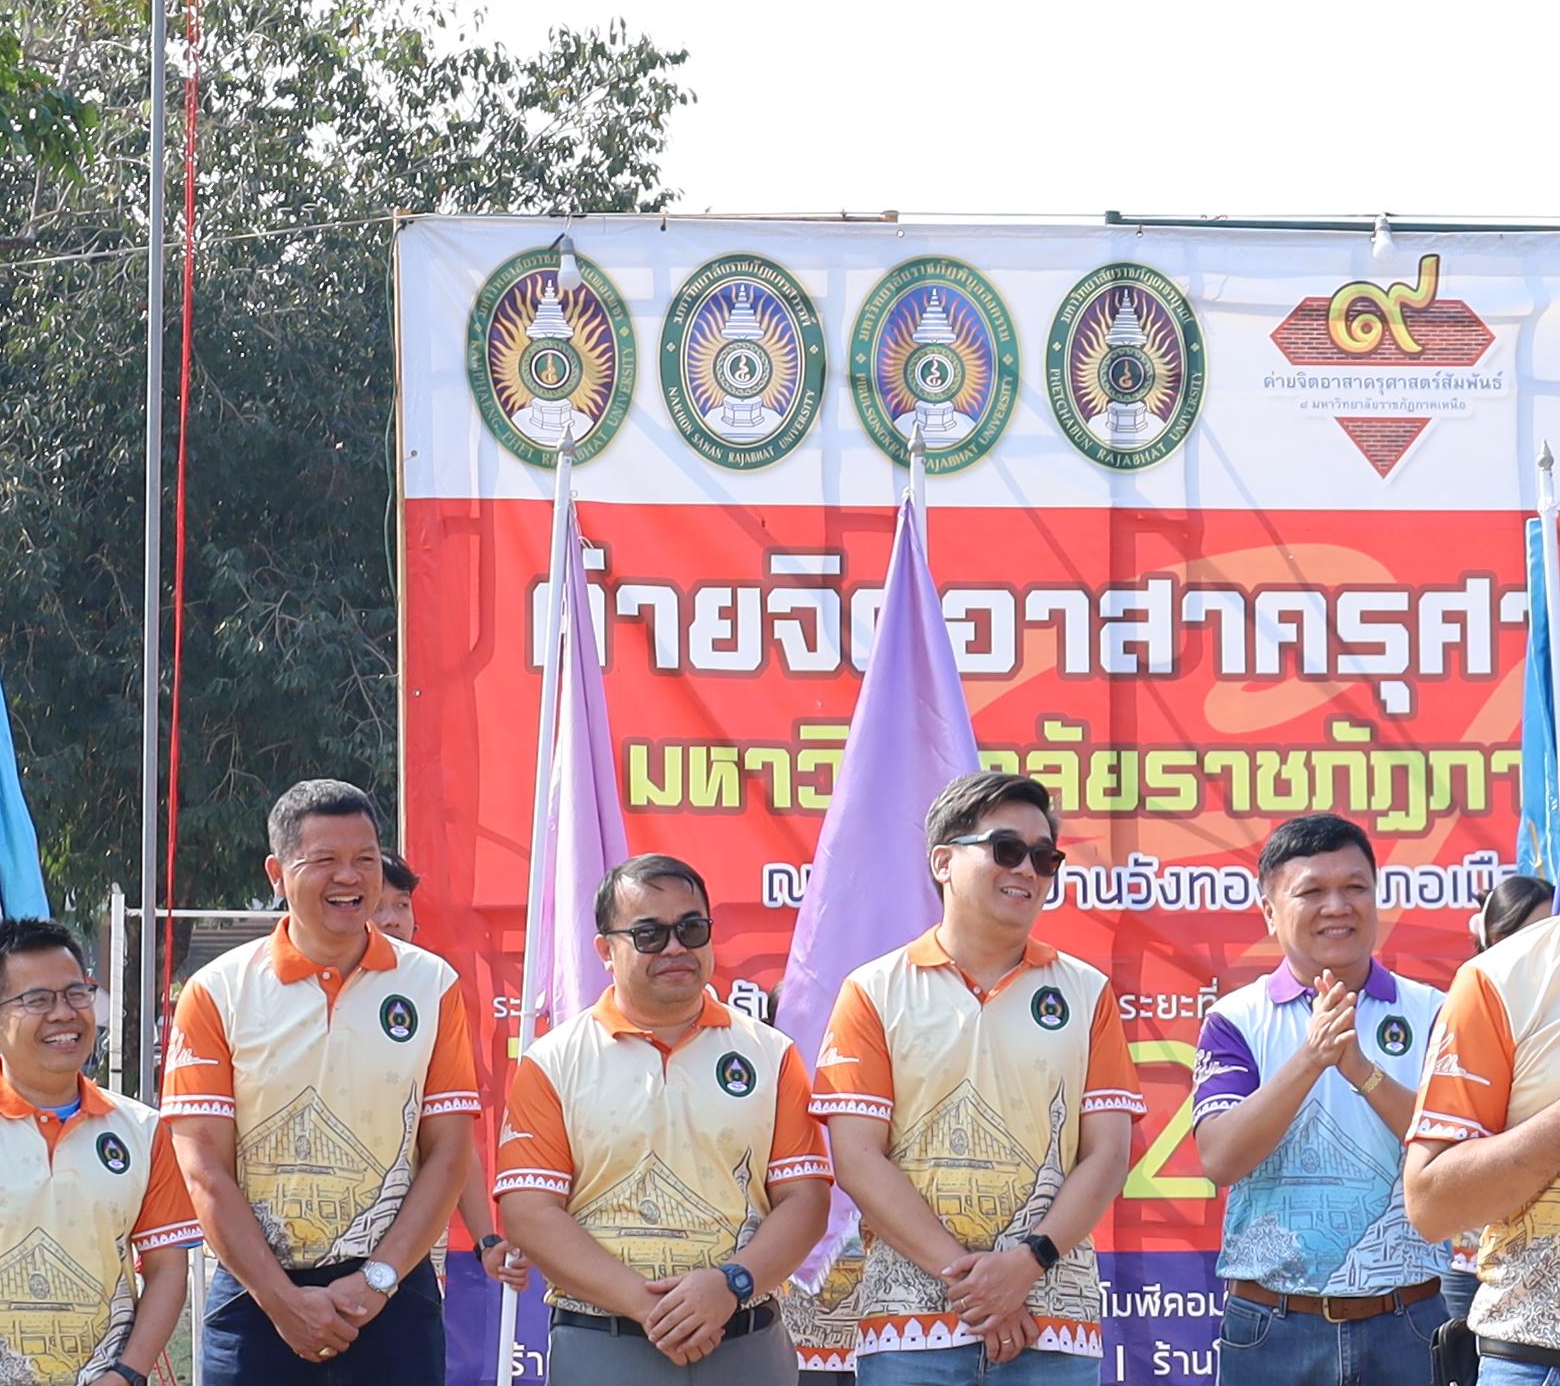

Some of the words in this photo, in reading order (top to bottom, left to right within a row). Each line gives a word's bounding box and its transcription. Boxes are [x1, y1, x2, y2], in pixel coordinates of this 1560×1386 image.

[471, 340, 502, 434] KAMPHAENG
[502, 430, 536, 460] PHET
[610, 346, 634, 427] UNIVERSITY
[668, 386, 694, 437] NAKHON
[690, 432, 724, 460] SAWAN
[727, 446, 776, 466] RAJABHAT
[779, 388, 816, 449] UNIVERSITY
[925, 443, 978, 473] AJABHAT
[978, 375, 1014, 446] UNIVERSITY
[1049, 368, 1093, 451] PHETCHABUN
[1096, 441, 1167, 468] RAJABHAT
[1170, 372, 1203, 442] UNIVERSITY
